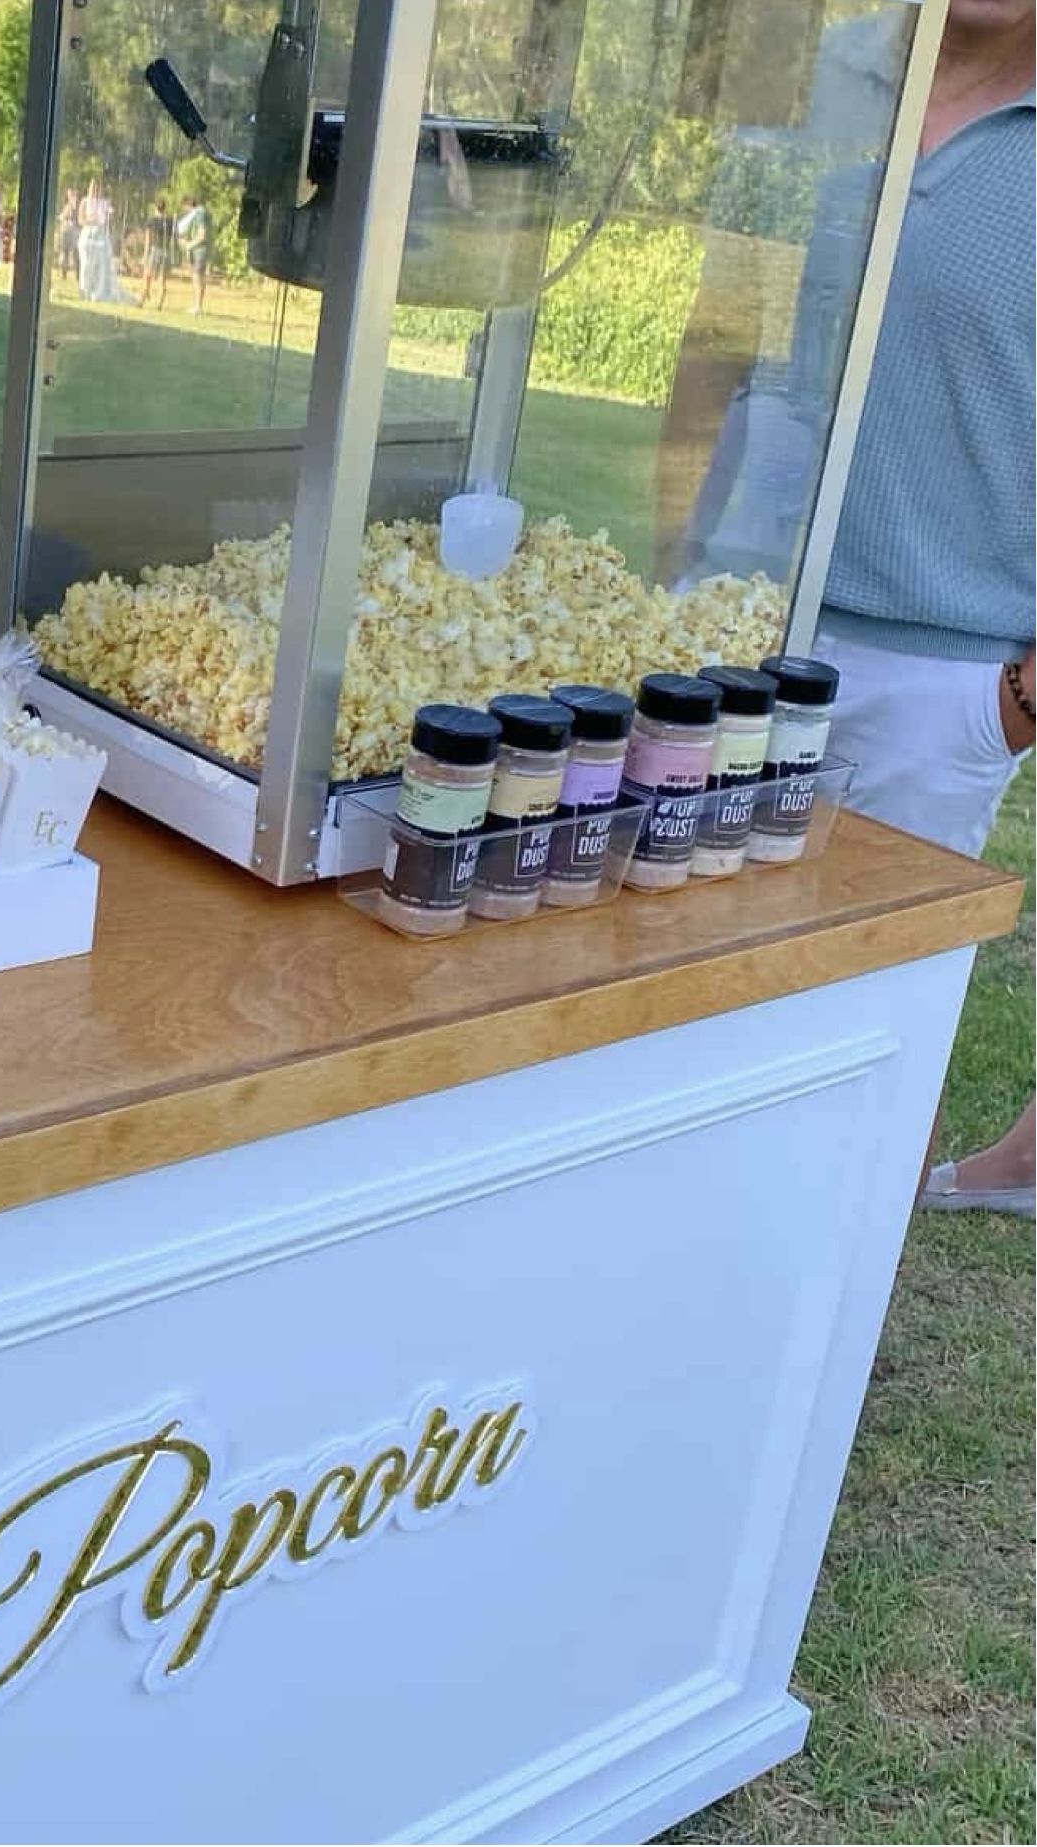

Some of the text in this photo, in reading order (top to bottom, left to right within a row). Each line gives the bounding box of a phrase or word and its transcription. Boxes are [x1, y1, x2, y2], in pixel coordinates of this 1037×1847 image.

[781, 793, 814, 811] DUST
[722, 803, 753, 824] DUST
[522, 845, 549, 868] DUS
